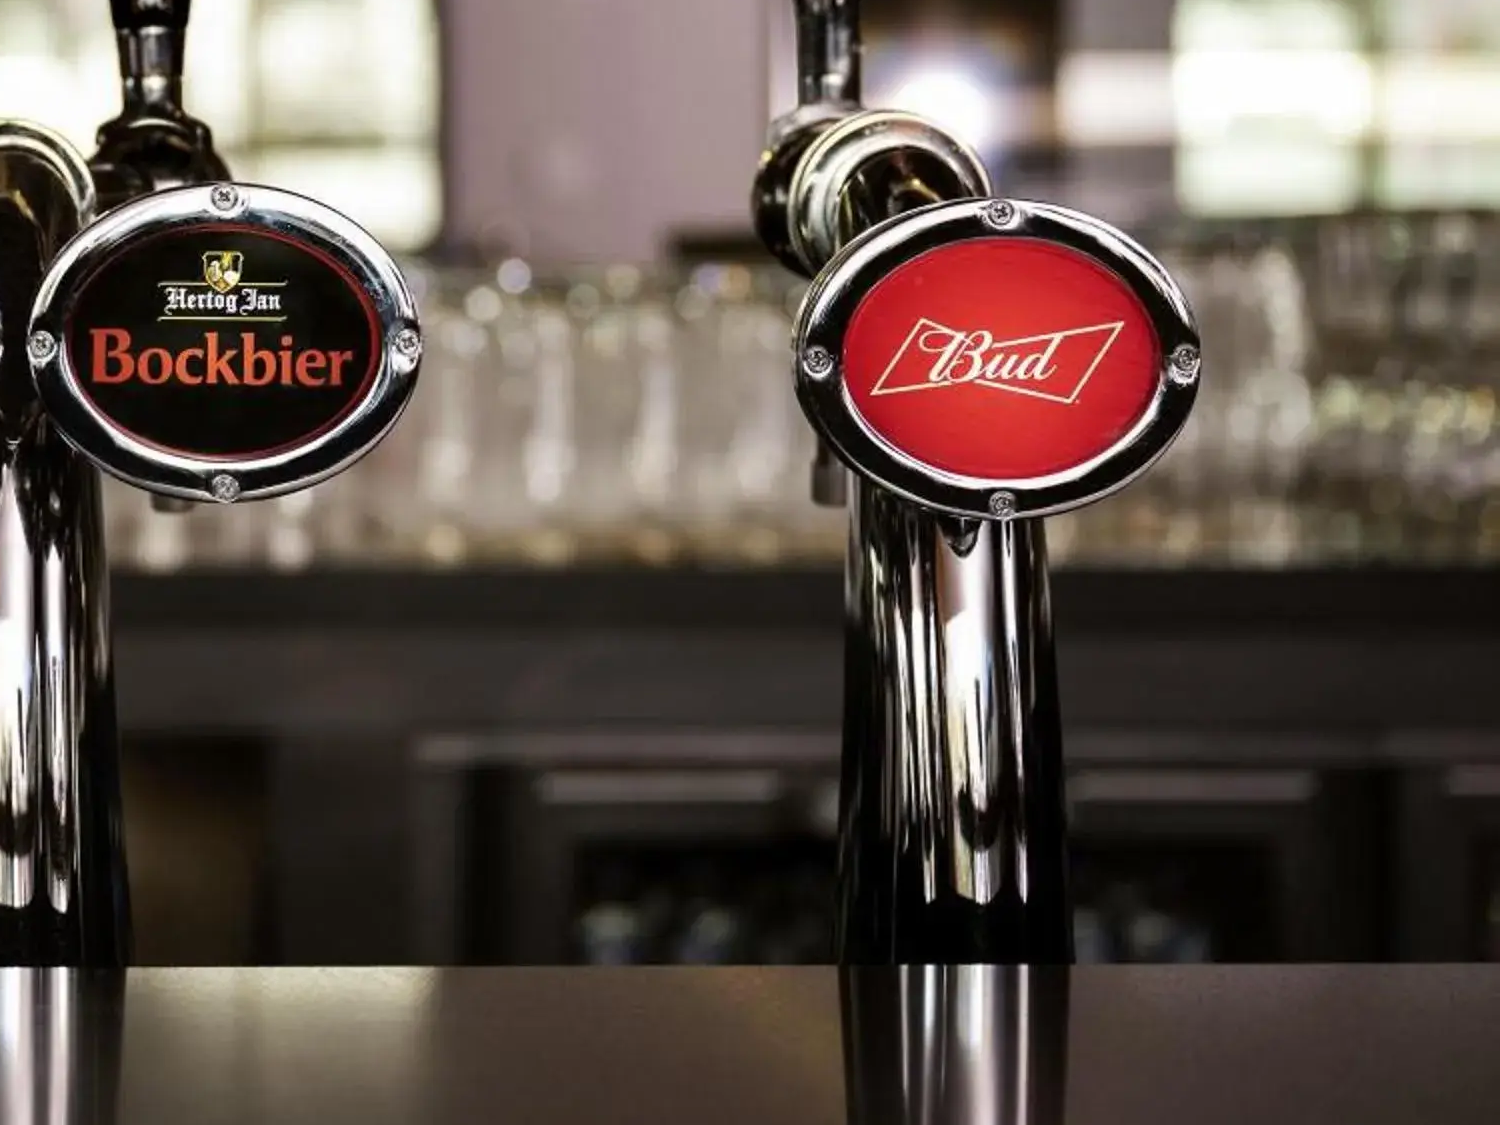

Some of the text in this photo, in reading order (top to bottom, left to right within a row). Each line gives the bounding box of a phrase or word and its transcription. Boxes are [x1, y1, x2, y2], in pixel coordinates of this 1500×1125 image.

[162, 286, 282, 315] Hertog Jan
[89, 327, 353, 386] Bockbier
[918, 330, 1058, 383] Bud
